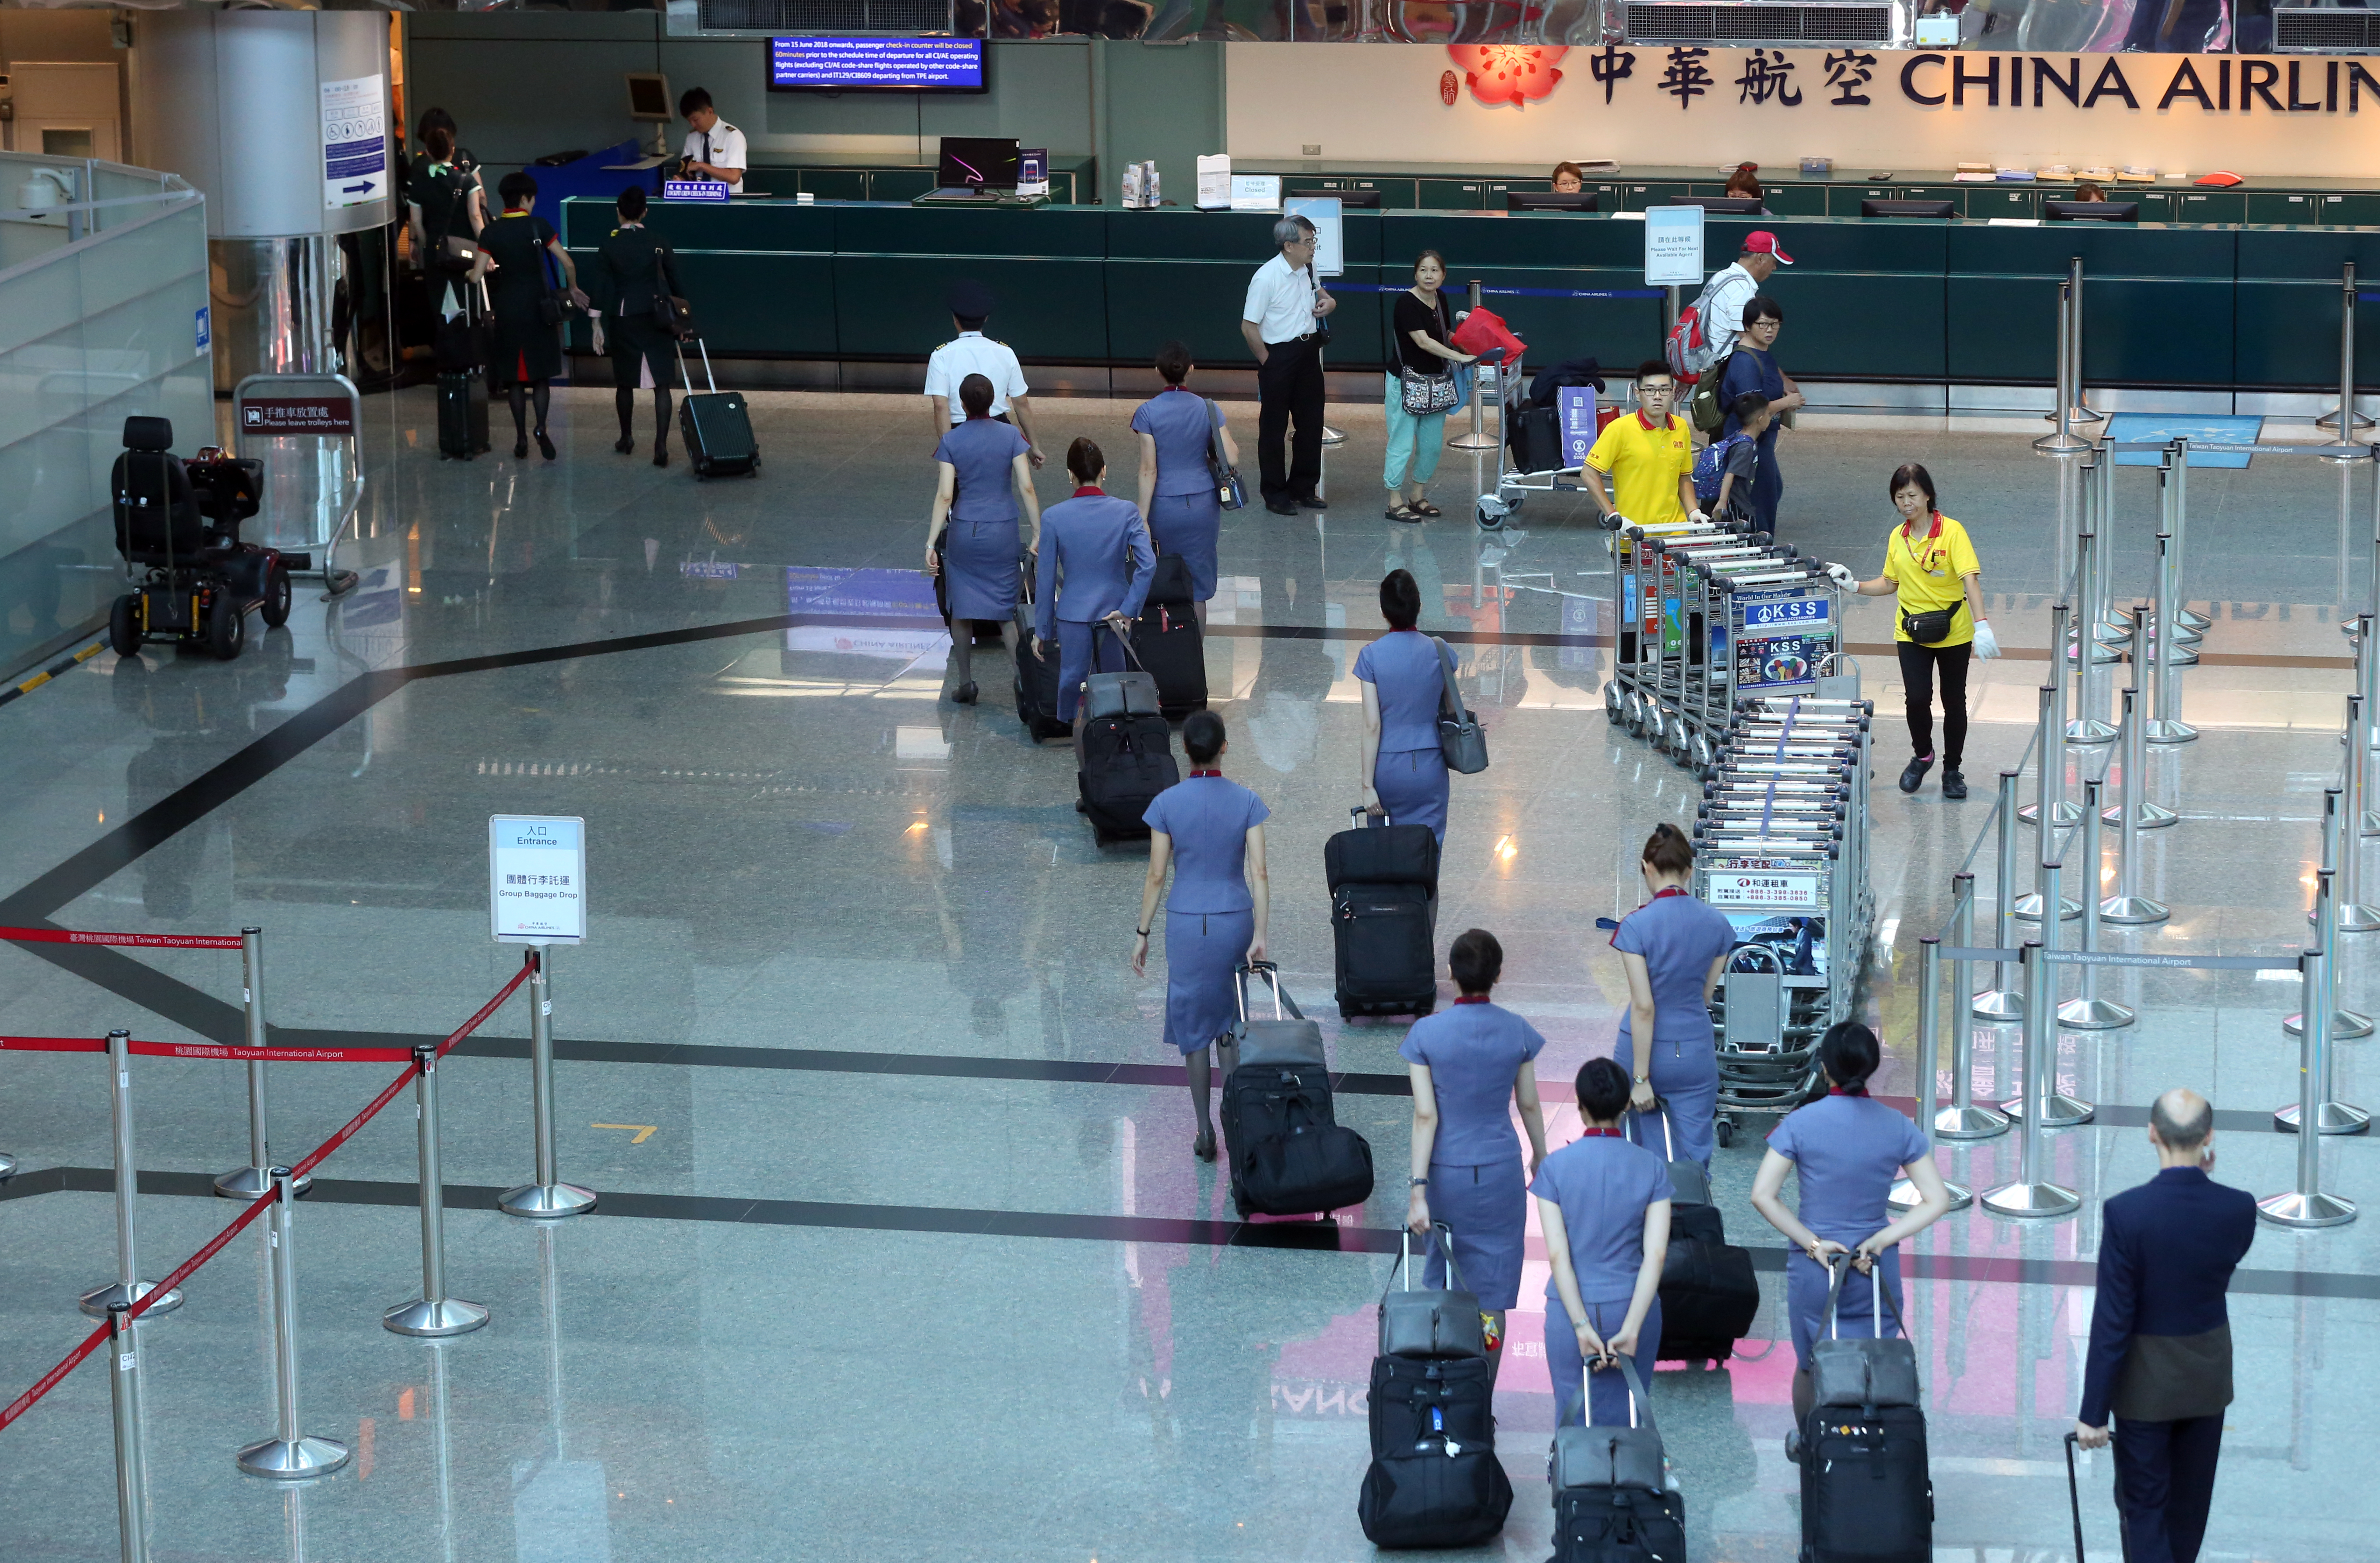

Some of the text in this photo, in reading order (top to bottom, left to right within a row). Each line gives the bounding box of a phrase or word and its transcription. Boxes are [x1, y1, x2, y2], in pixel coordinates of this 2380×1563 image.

[1591, 46, 1873, 109] 中華航空
[1900, 54, 2140, 109] CHINA
[264, 406, 328, 418] 手推車放置處
[308, 419, 332, 428] trolleys
[1773, 602, 1817, 618] KSS
[1771, 641, 1800, 653] KSS
[527, 826, 547, 836] 入口
[1729, 860, 1771, 868] 行李宅配
[507, 874, 570, 886] 團體行李託運
[1752, 879, 1789, 888] 和運租車
[499, 890, 522, 898] Group
[525, 891, 557, 899] Baggage
[70, 933, 134, 944] 臺灣桃園國際機場
[135, 936, 161, 944] Taiwan
[163, 936, 194, 946] Taoyuan
[2043, 952, 2191, 967] Taiwan Taoyuan International Airport
[175, 1046, 343, 1059] 桃園國際機場 Taoyuan International Airport
[191, 1253, 205, 1267] Taoyuan
[205, 1233, 226, 1256] International
[226, 1224, 238, 1239] Airport
[32, 1382, 46, 1398] Taoyuan
[46, 1360, 69, 1385] International
[69, 1350, 81, 1366] Airport
